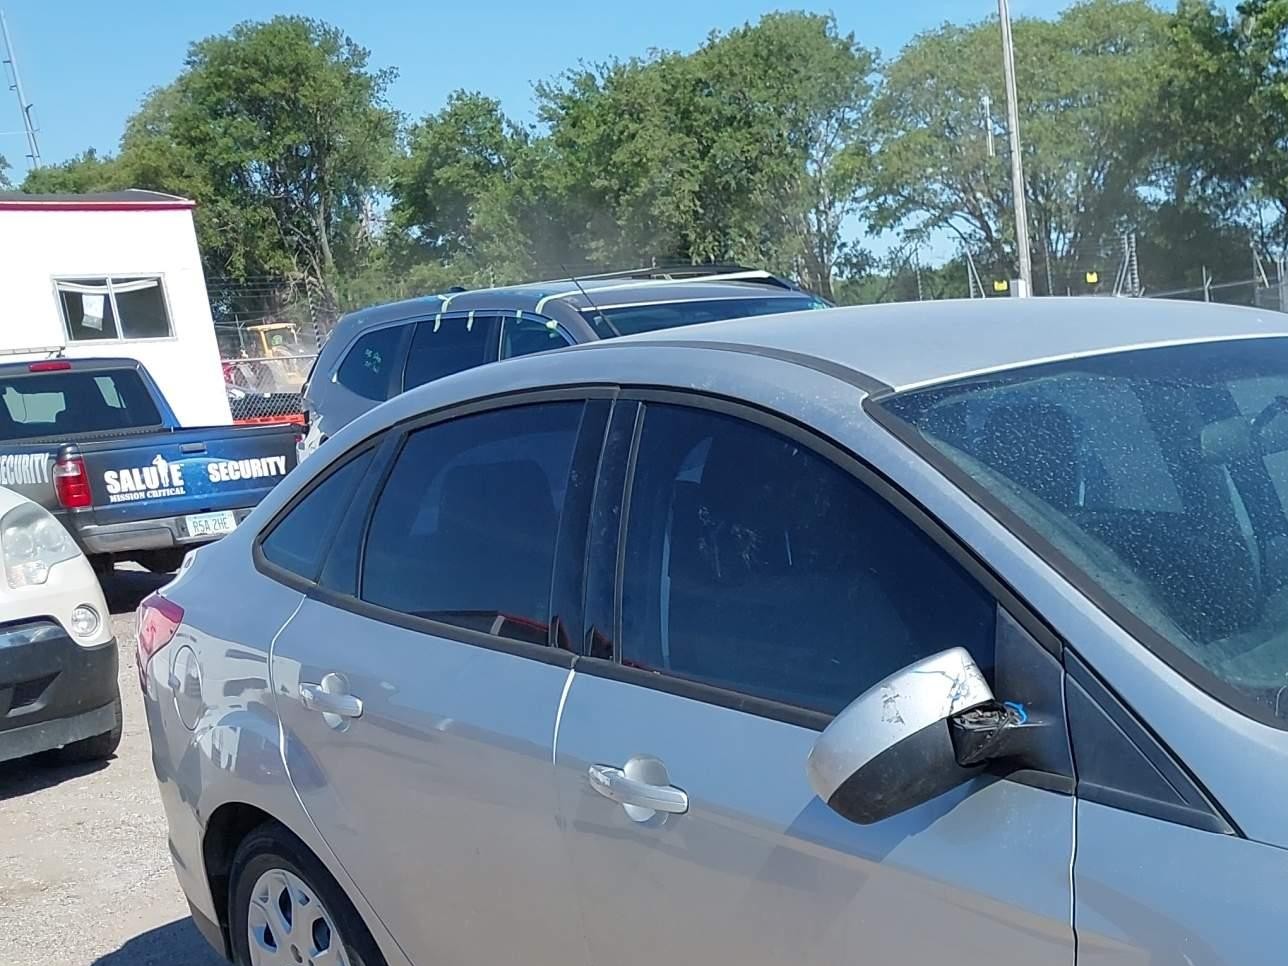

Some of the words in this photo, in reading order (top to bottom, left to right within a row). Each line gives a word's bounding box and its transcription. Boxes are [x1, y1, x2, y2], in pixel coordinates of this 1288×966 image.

[0, 452, 49, 485] ECURITY
[207, 455, 286, 483] SECURITY
[109, 491, 146, 503] MISSION
[146, 487, 186, 499] CRITICAL
